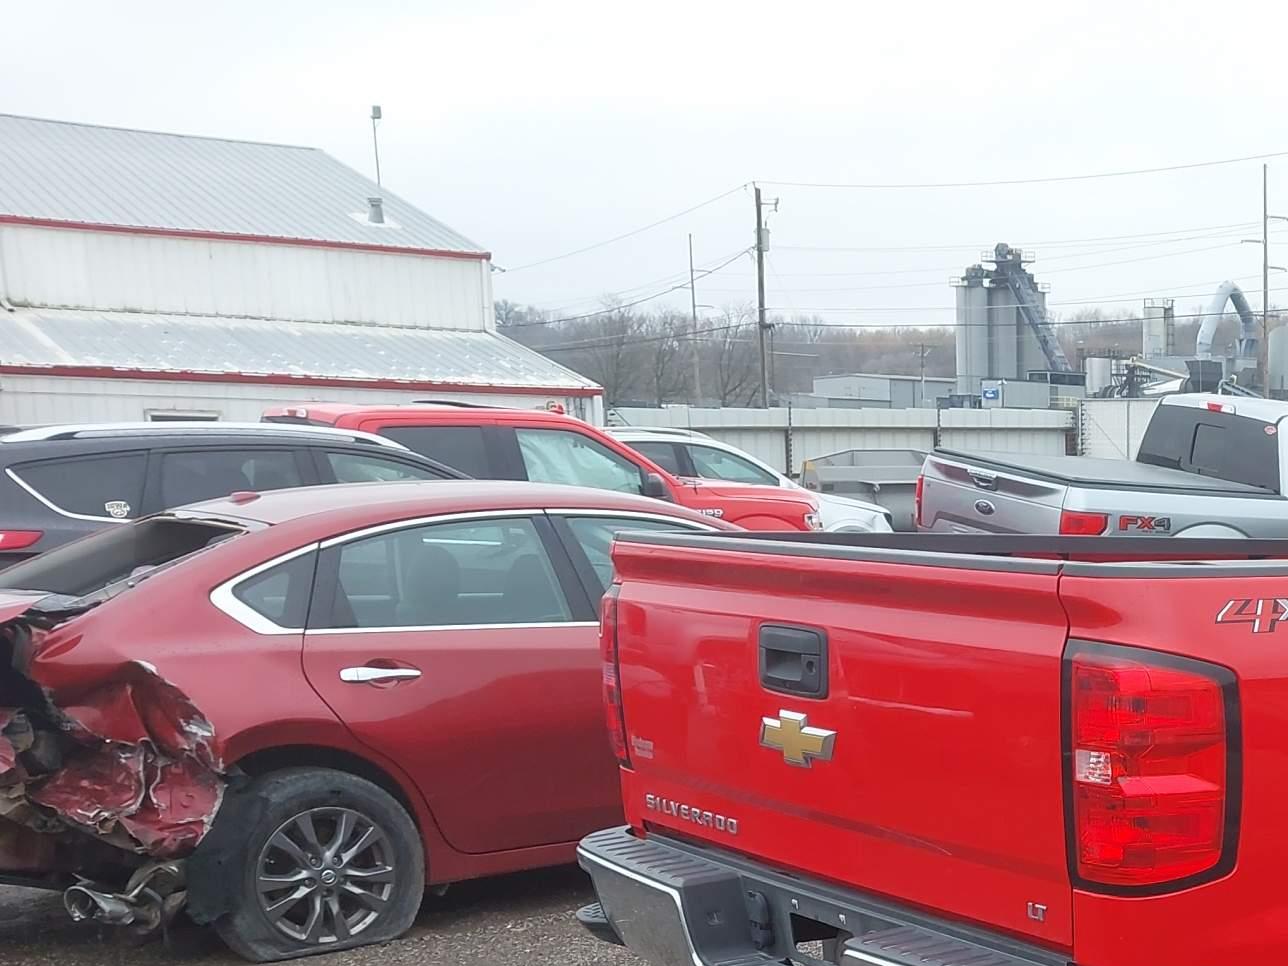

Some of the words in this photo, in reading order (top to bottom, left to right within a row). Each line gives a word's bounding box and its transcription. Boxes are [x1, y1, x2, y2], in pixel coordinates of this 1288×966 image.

[1119, 515, 1171, 531] FX4
[645, 793, 739, 834] SILVERADO
[1027, 902, 1047, 922] LT
